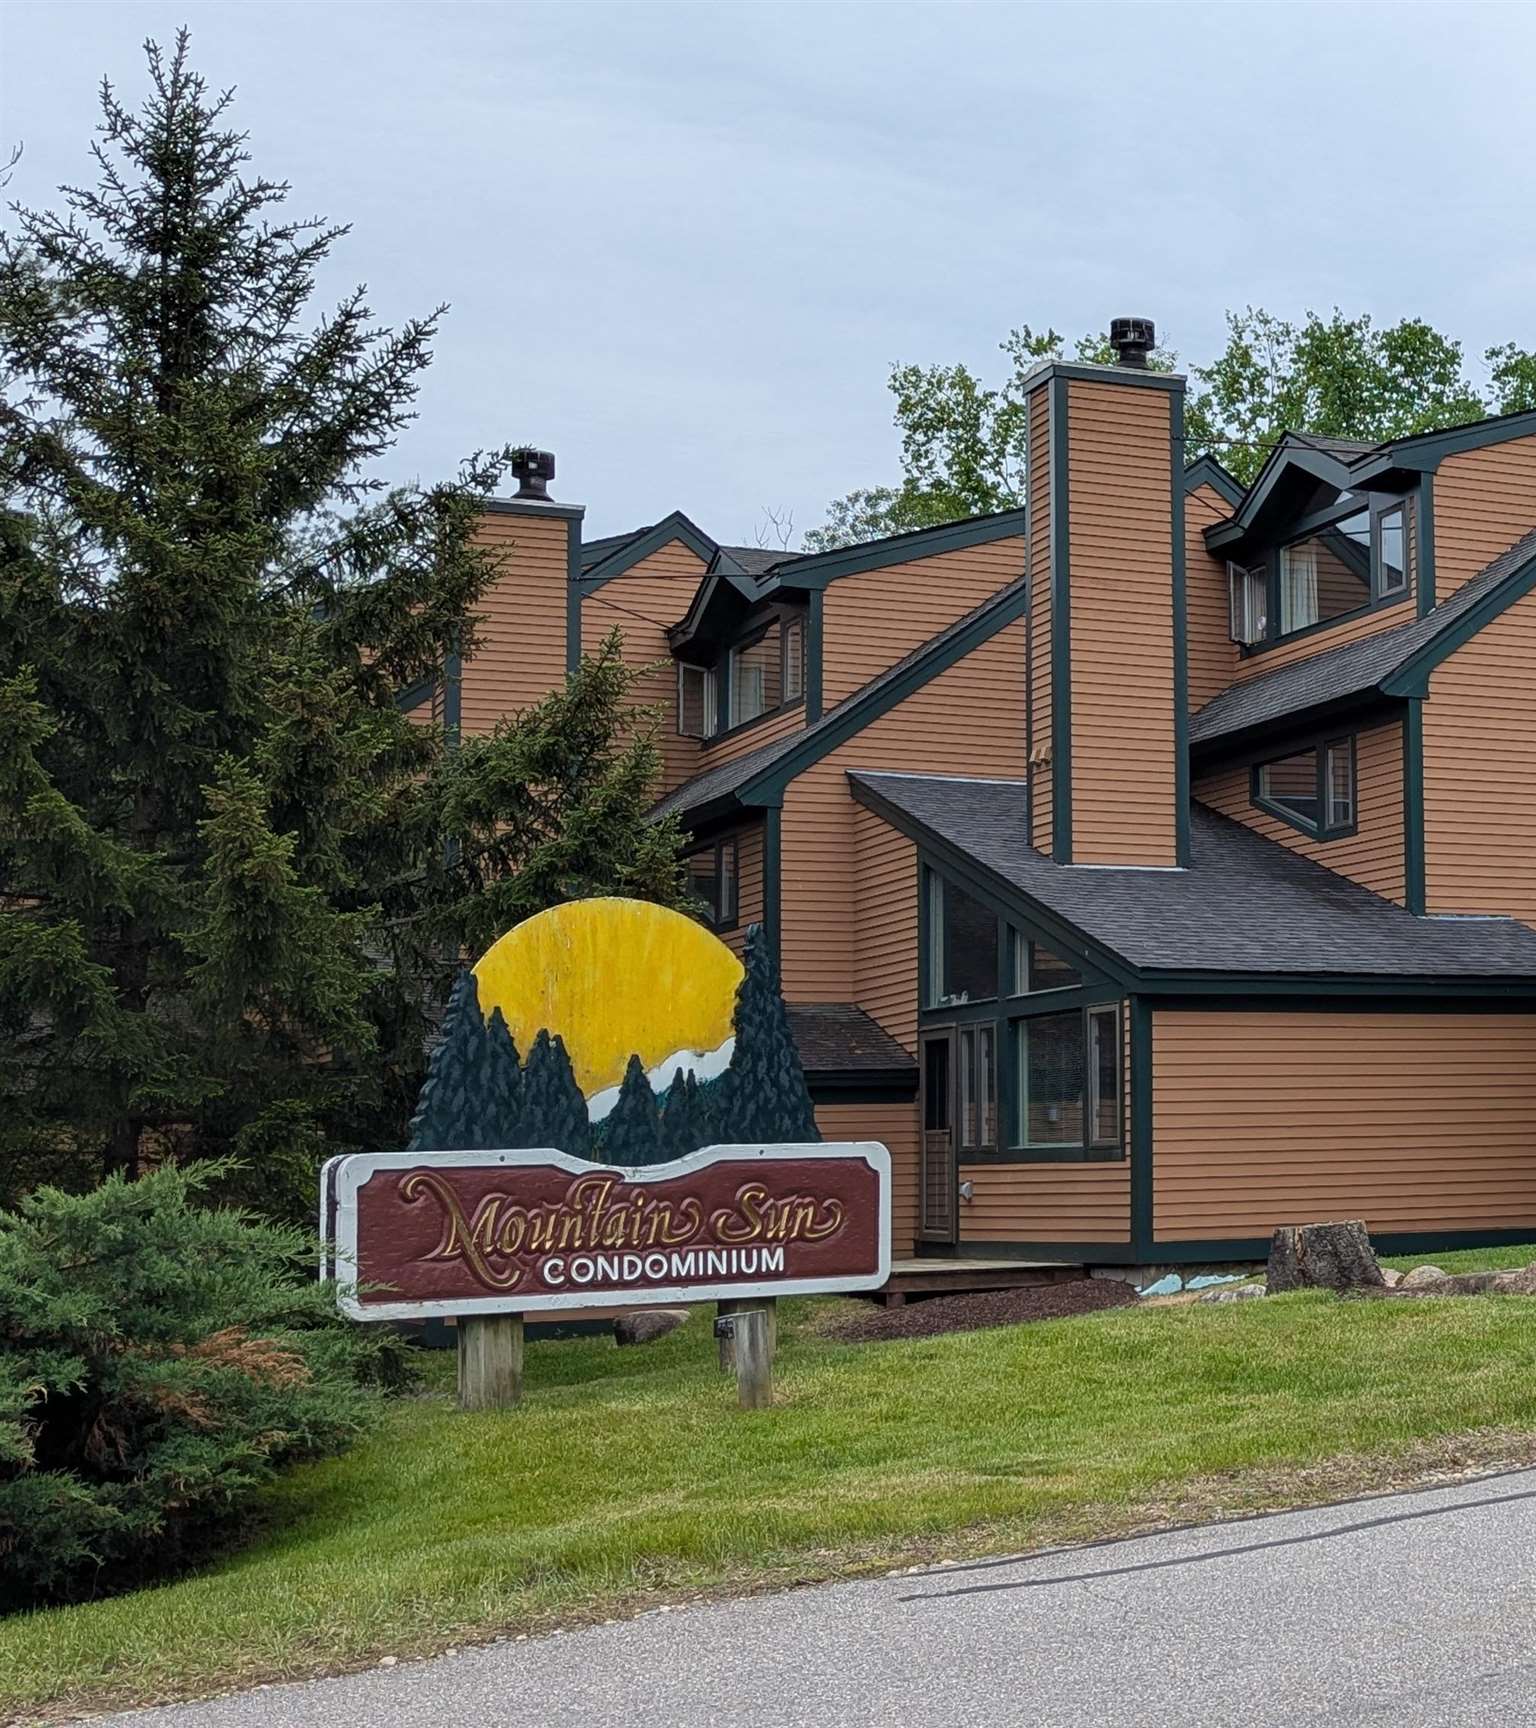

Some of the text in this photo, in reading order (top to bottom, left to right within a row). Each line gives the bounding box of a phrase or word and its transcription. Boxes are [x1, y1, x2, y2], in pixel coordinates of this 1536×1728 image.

[402, 1174, 842, 1287] Mountain Sun
[542, 1247, 785, 1284] CONDOMINIUM
